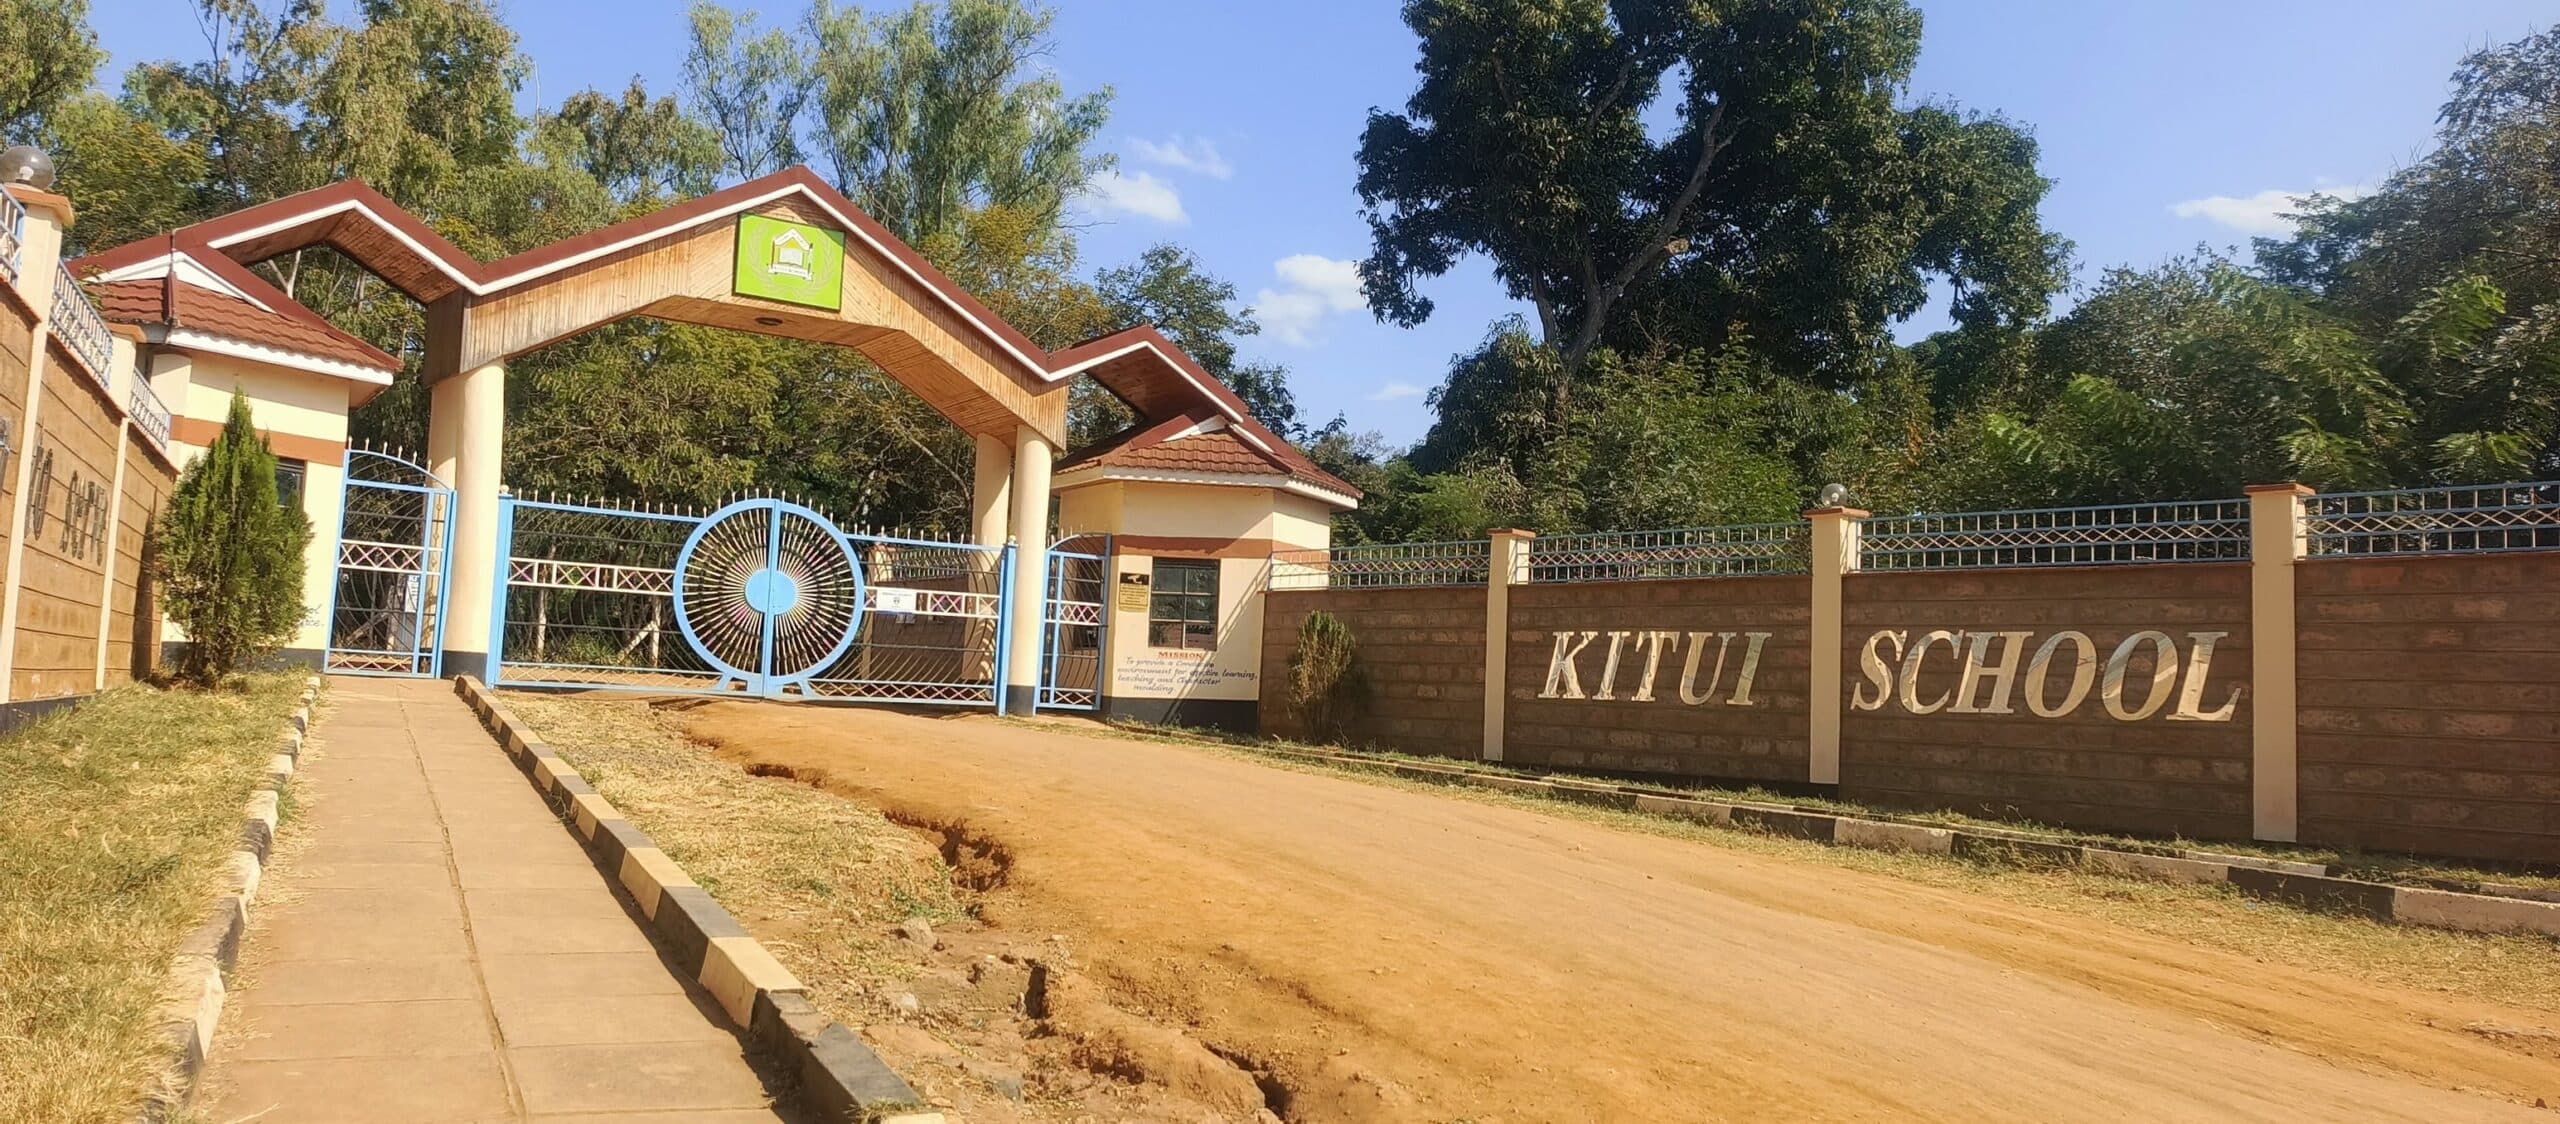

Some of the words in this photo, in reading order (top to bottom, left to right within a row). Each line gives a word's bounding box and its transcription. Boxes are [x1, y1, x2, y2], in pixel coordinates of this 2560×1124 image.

[1158, 651, 1203, 660] MISSION
[1173, 668, 1188, 678] for
[1537, 630, 1773, 706] KITUI
[1850, 629, 2242, 722] SCHOOL
[1118, 674, 1154, 685] teaching
[1156, 675, 1174, 683] and
